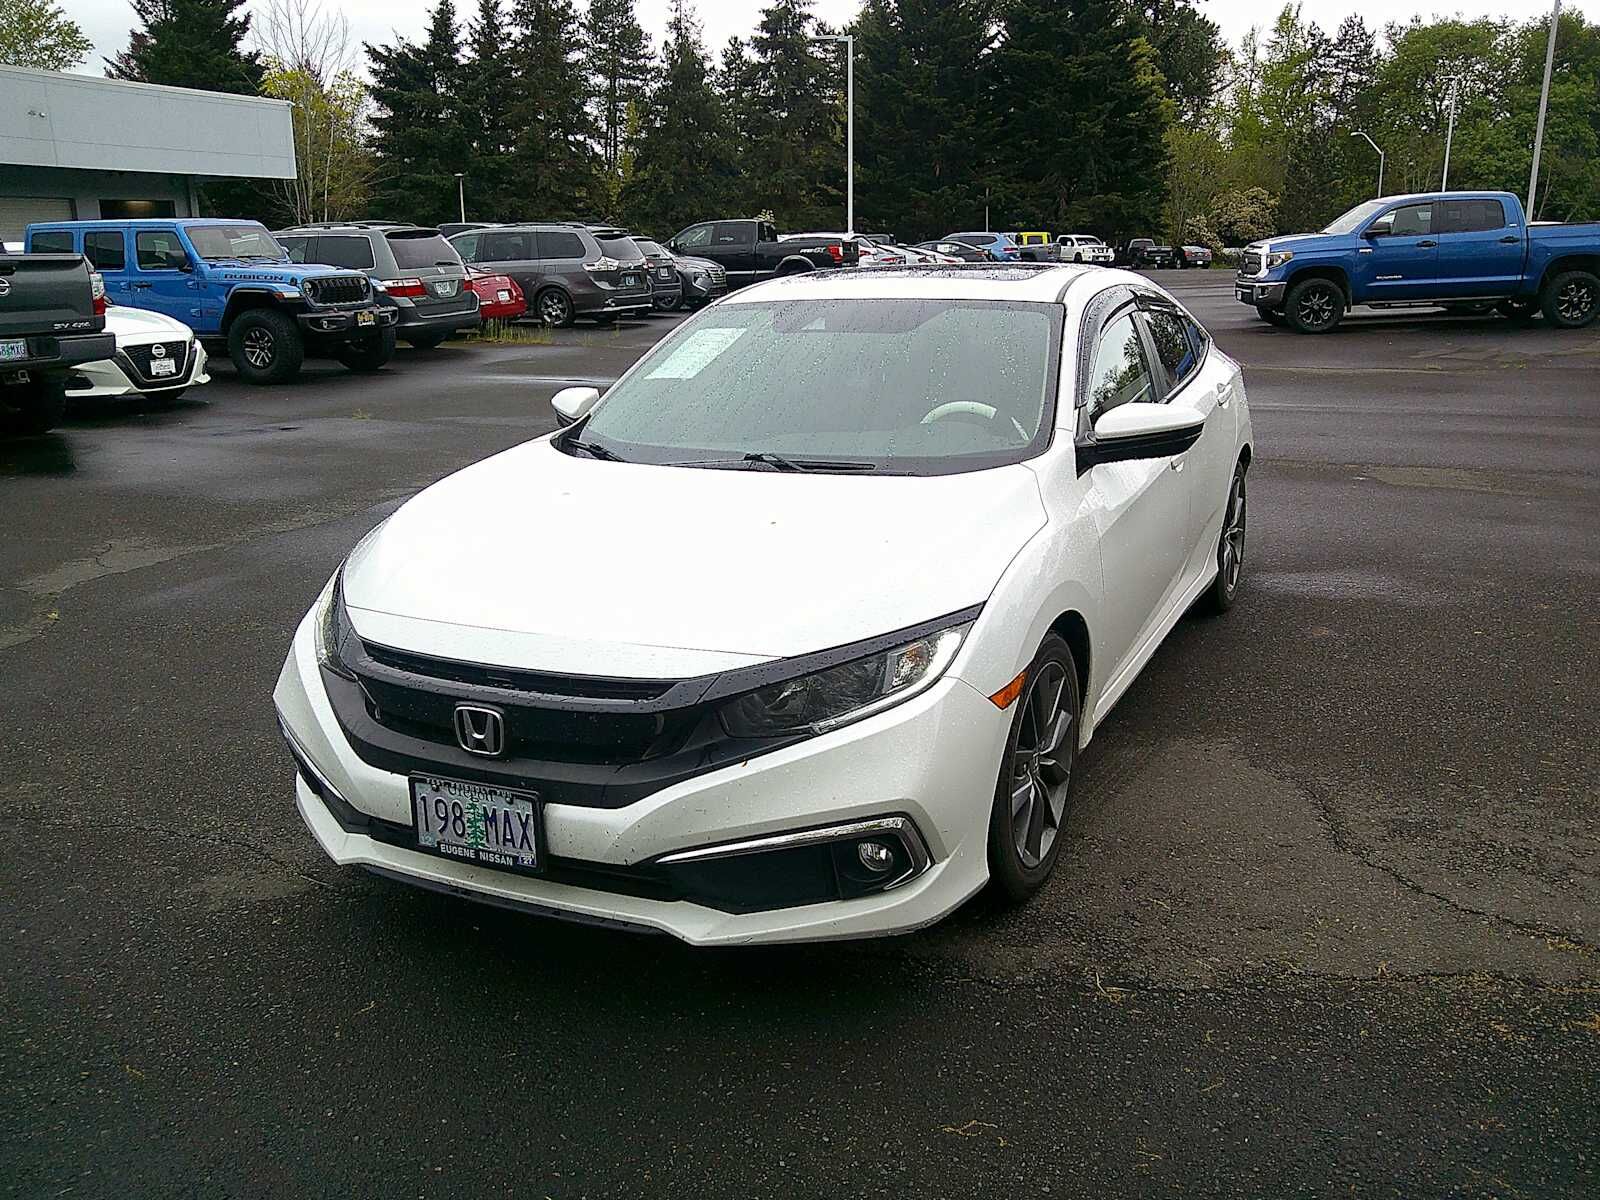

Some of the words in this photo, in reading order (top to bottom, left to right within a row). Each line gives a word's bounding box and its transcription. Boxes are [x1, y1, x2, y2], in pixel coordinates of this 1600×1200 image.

[420, 794, 466, 838] 198
[482, 805, 534, 851] MAX
[440, 843, 476, 859] EUGENE
[480, 851, 513, 866] NISSAN
